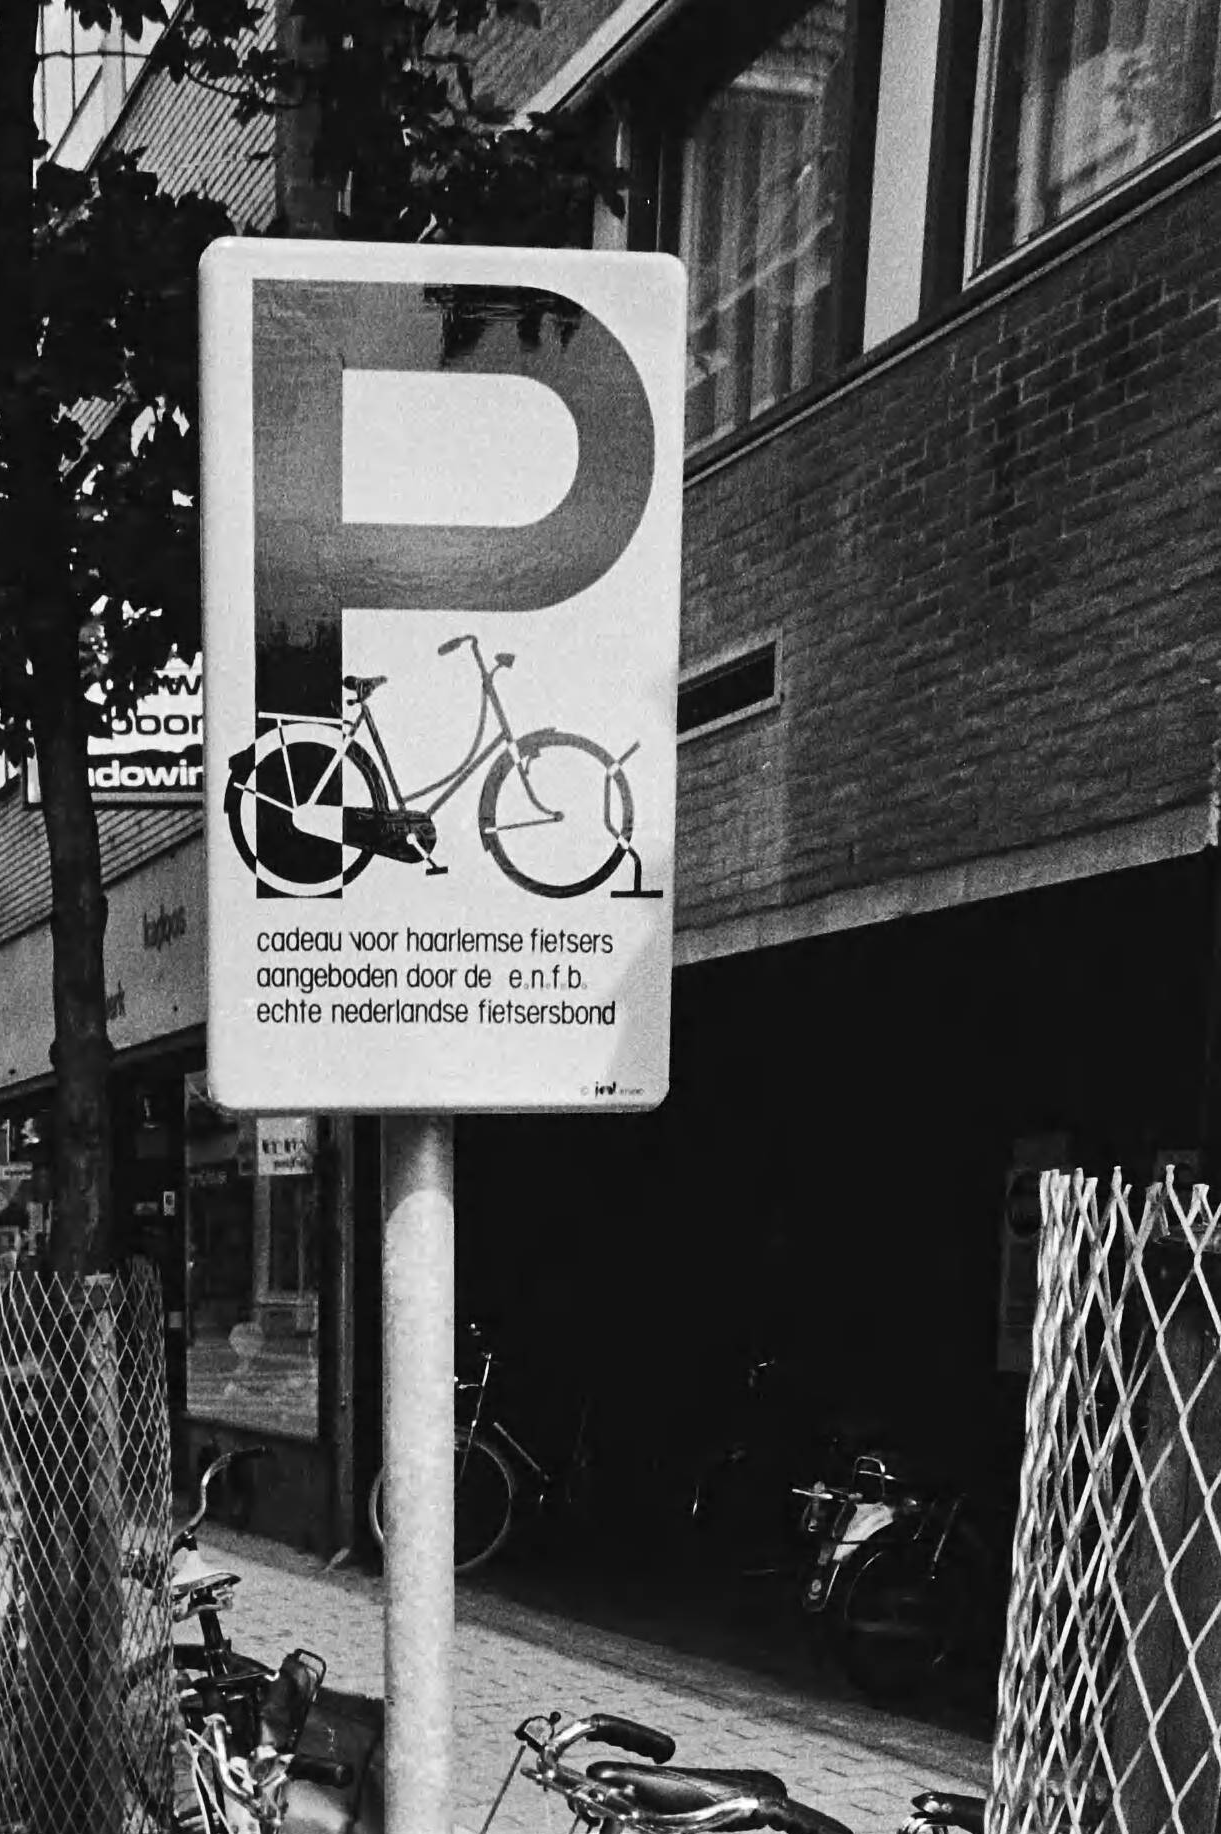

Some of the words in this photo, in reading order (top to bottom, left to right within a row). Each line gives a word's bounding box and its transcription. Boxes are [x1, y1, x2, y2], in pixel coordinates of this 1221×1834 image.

[253, 279, 655, 898] P
[257, 926, 342, 952] cadeau
[349, 931, 399, 952] voor
[407, 926, 523, 953] haarlemse
[530, 927, 614, 954] fietsers
[257, 963, 397, 994] aangeboden
[406, 963, 457, 988] door
[464, 964, 491, 988] de
[509, 964, 587, 990] e.n.f.b.
[257, 998, 322, 1024] echte
[331, 997, 469, 1024] nederlandse
[479, 998, 616, 1025] fietsersbond
